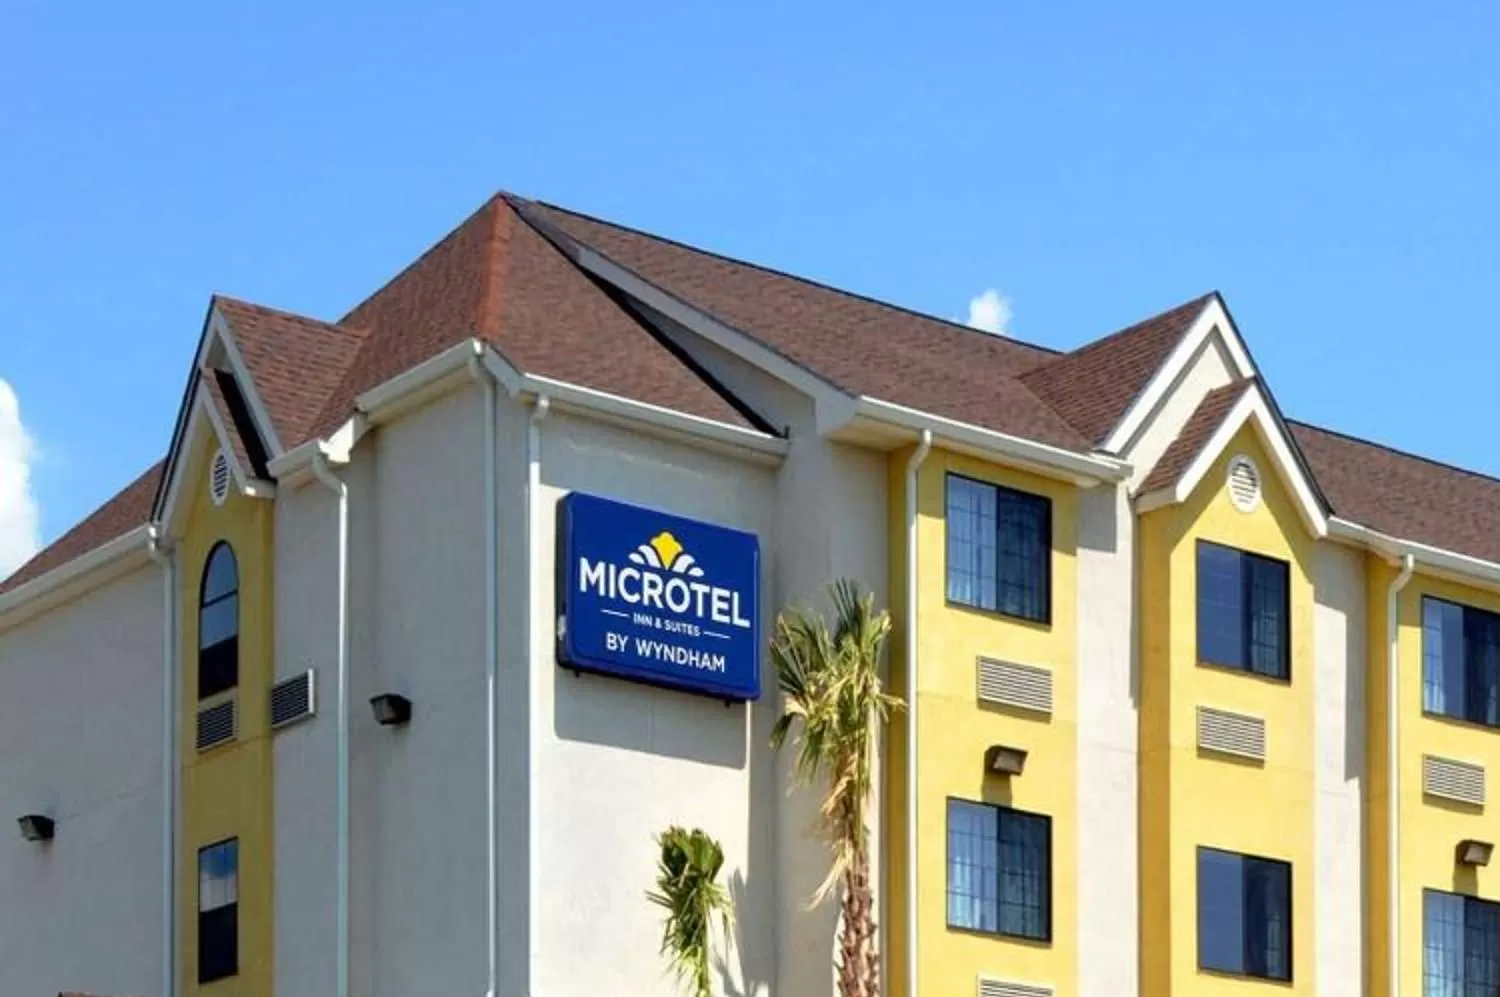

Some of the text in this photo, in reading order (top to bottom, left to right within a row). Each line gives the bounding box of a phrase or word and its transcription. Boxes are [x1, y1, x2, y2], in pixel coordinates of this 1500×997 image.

[579, 557, 751, 628] MICROTEL
[633, 612, 701, 637] INN & SUITES
[606, 632, 726, 673] BY WYNDHAM
